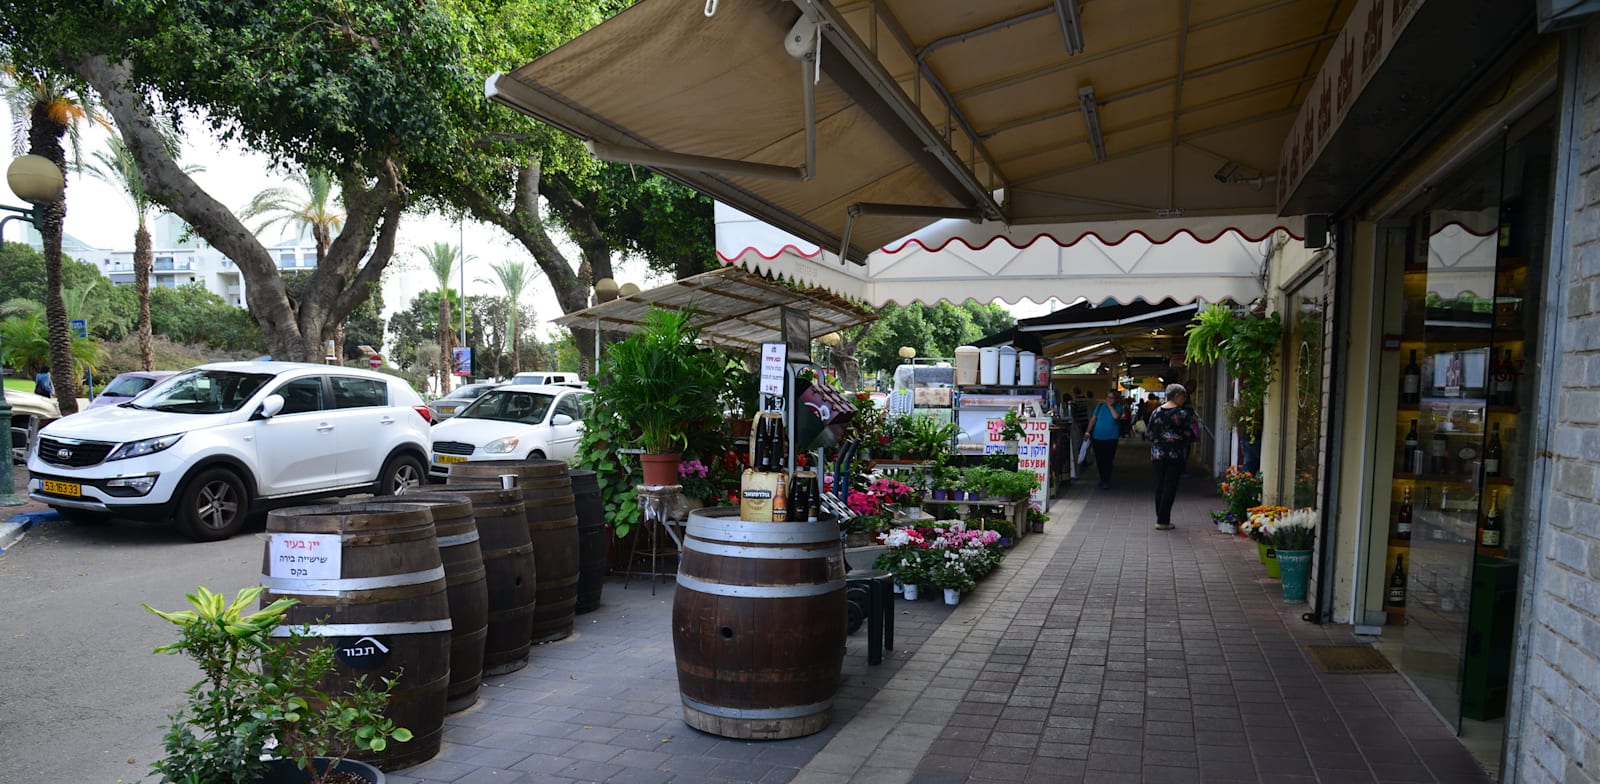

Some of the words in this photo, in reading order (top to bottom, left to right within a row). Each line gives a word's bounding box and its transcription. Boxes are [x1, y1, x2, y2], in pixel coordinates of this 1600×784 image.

[1022, 421, 1048, 431] סנדל
[283, 540, 305, 549] בעיר
[308, 540, 320, 551] יין
[280, 555, 296, 563] בירה
[290, 568, 308, 577] בקס
[343, 647, 374, 657] תבור
